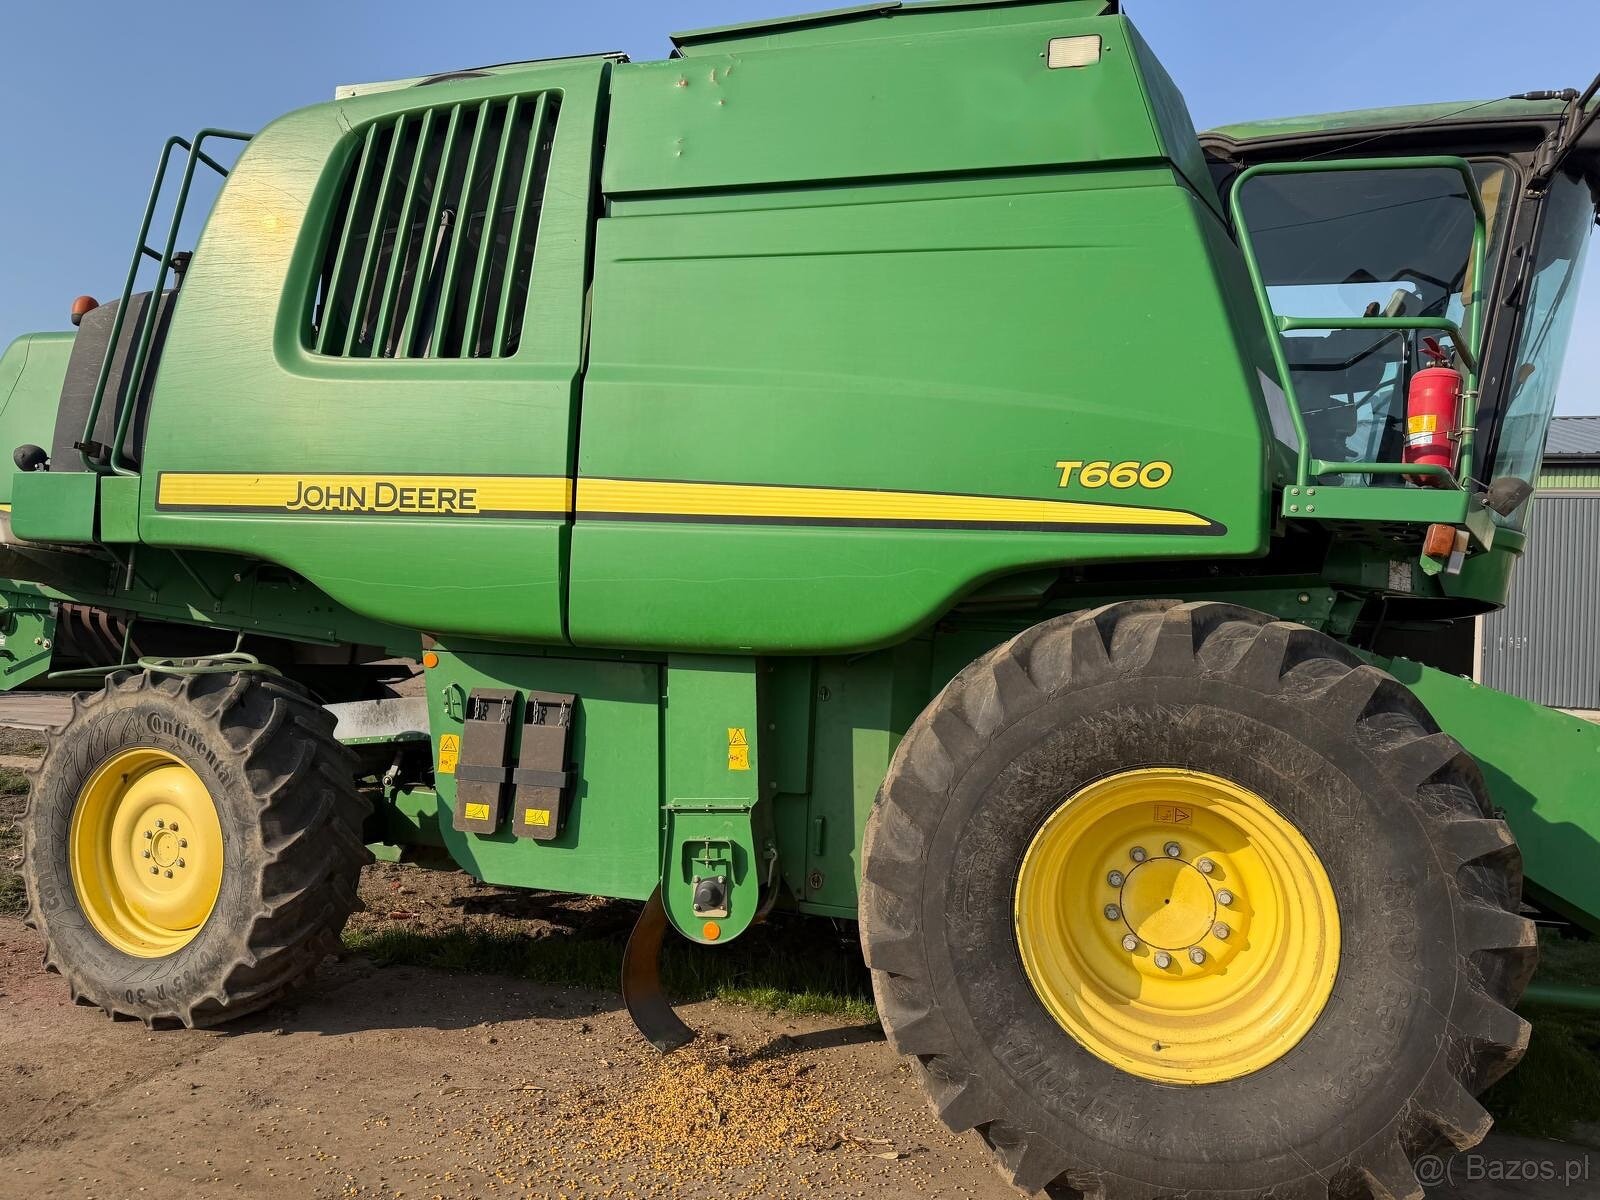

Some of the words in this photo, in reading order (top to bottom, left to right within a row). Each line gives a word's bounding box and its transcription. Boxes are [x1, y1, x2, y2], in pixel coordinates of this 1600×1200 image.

[1055, 460, 1174, 490] T660
[287, 480, 367, 510] JOHN
[374, 481, 479, 512] DEERE
